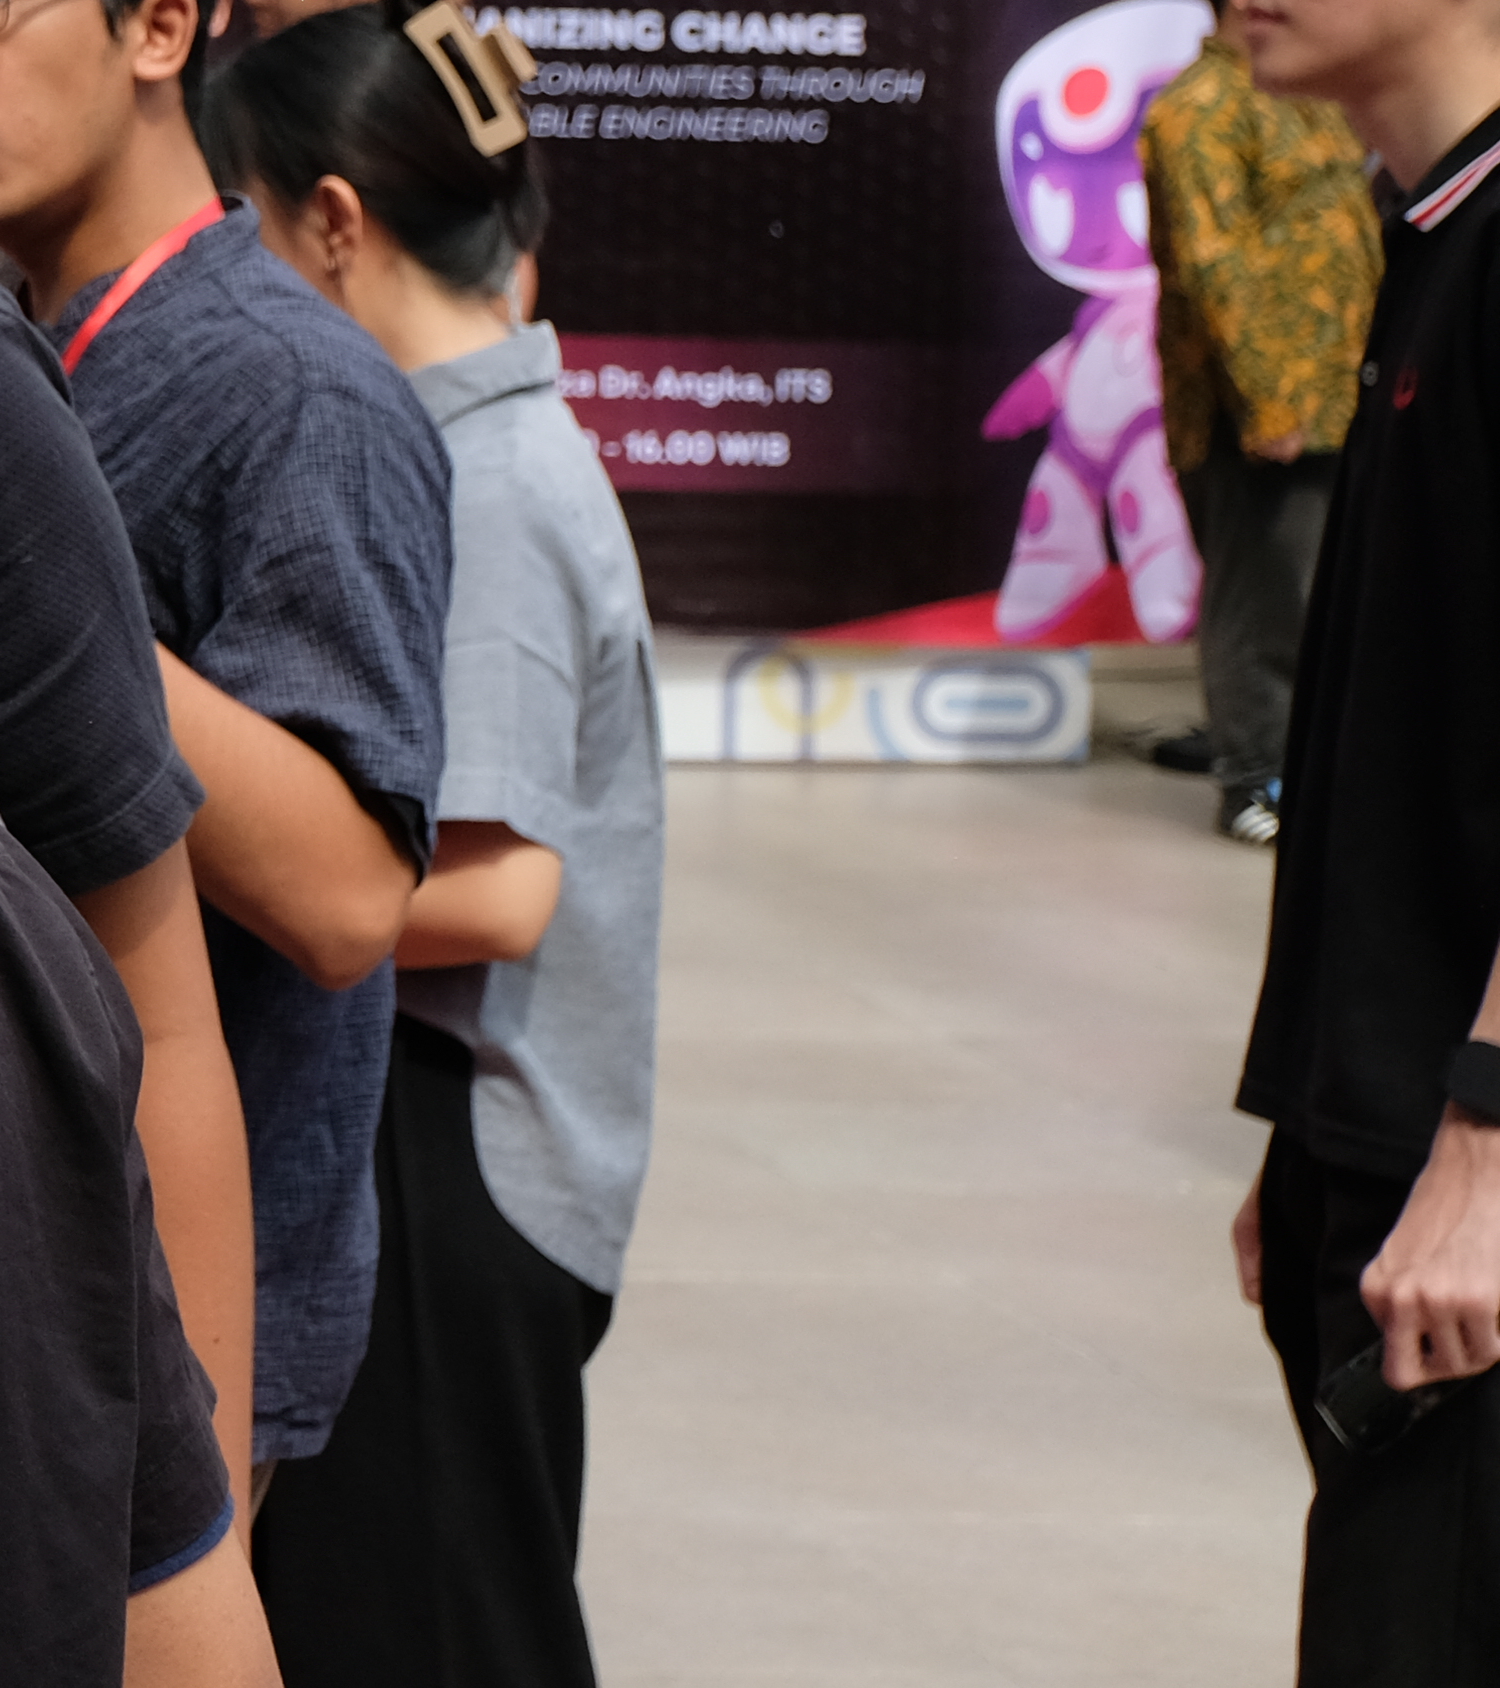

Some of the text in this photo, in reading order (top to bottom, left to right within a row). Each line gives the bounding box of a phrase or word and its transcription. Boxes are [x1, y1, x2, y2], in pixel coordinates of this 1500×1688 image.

[463, 5, 868, 57] ANIZING CHANGE
[758, 64, 926, 105] THROUGH
[598, 104, 830, 145] ENGINEERING
[599, 363, 652, 400] Dr.
[652, 364, 774, 409] Angka,
[774, 368, 834, 404] ITS
[622, 428, 717, 466] 16.00
[717, 430, 792, 467] WIB
